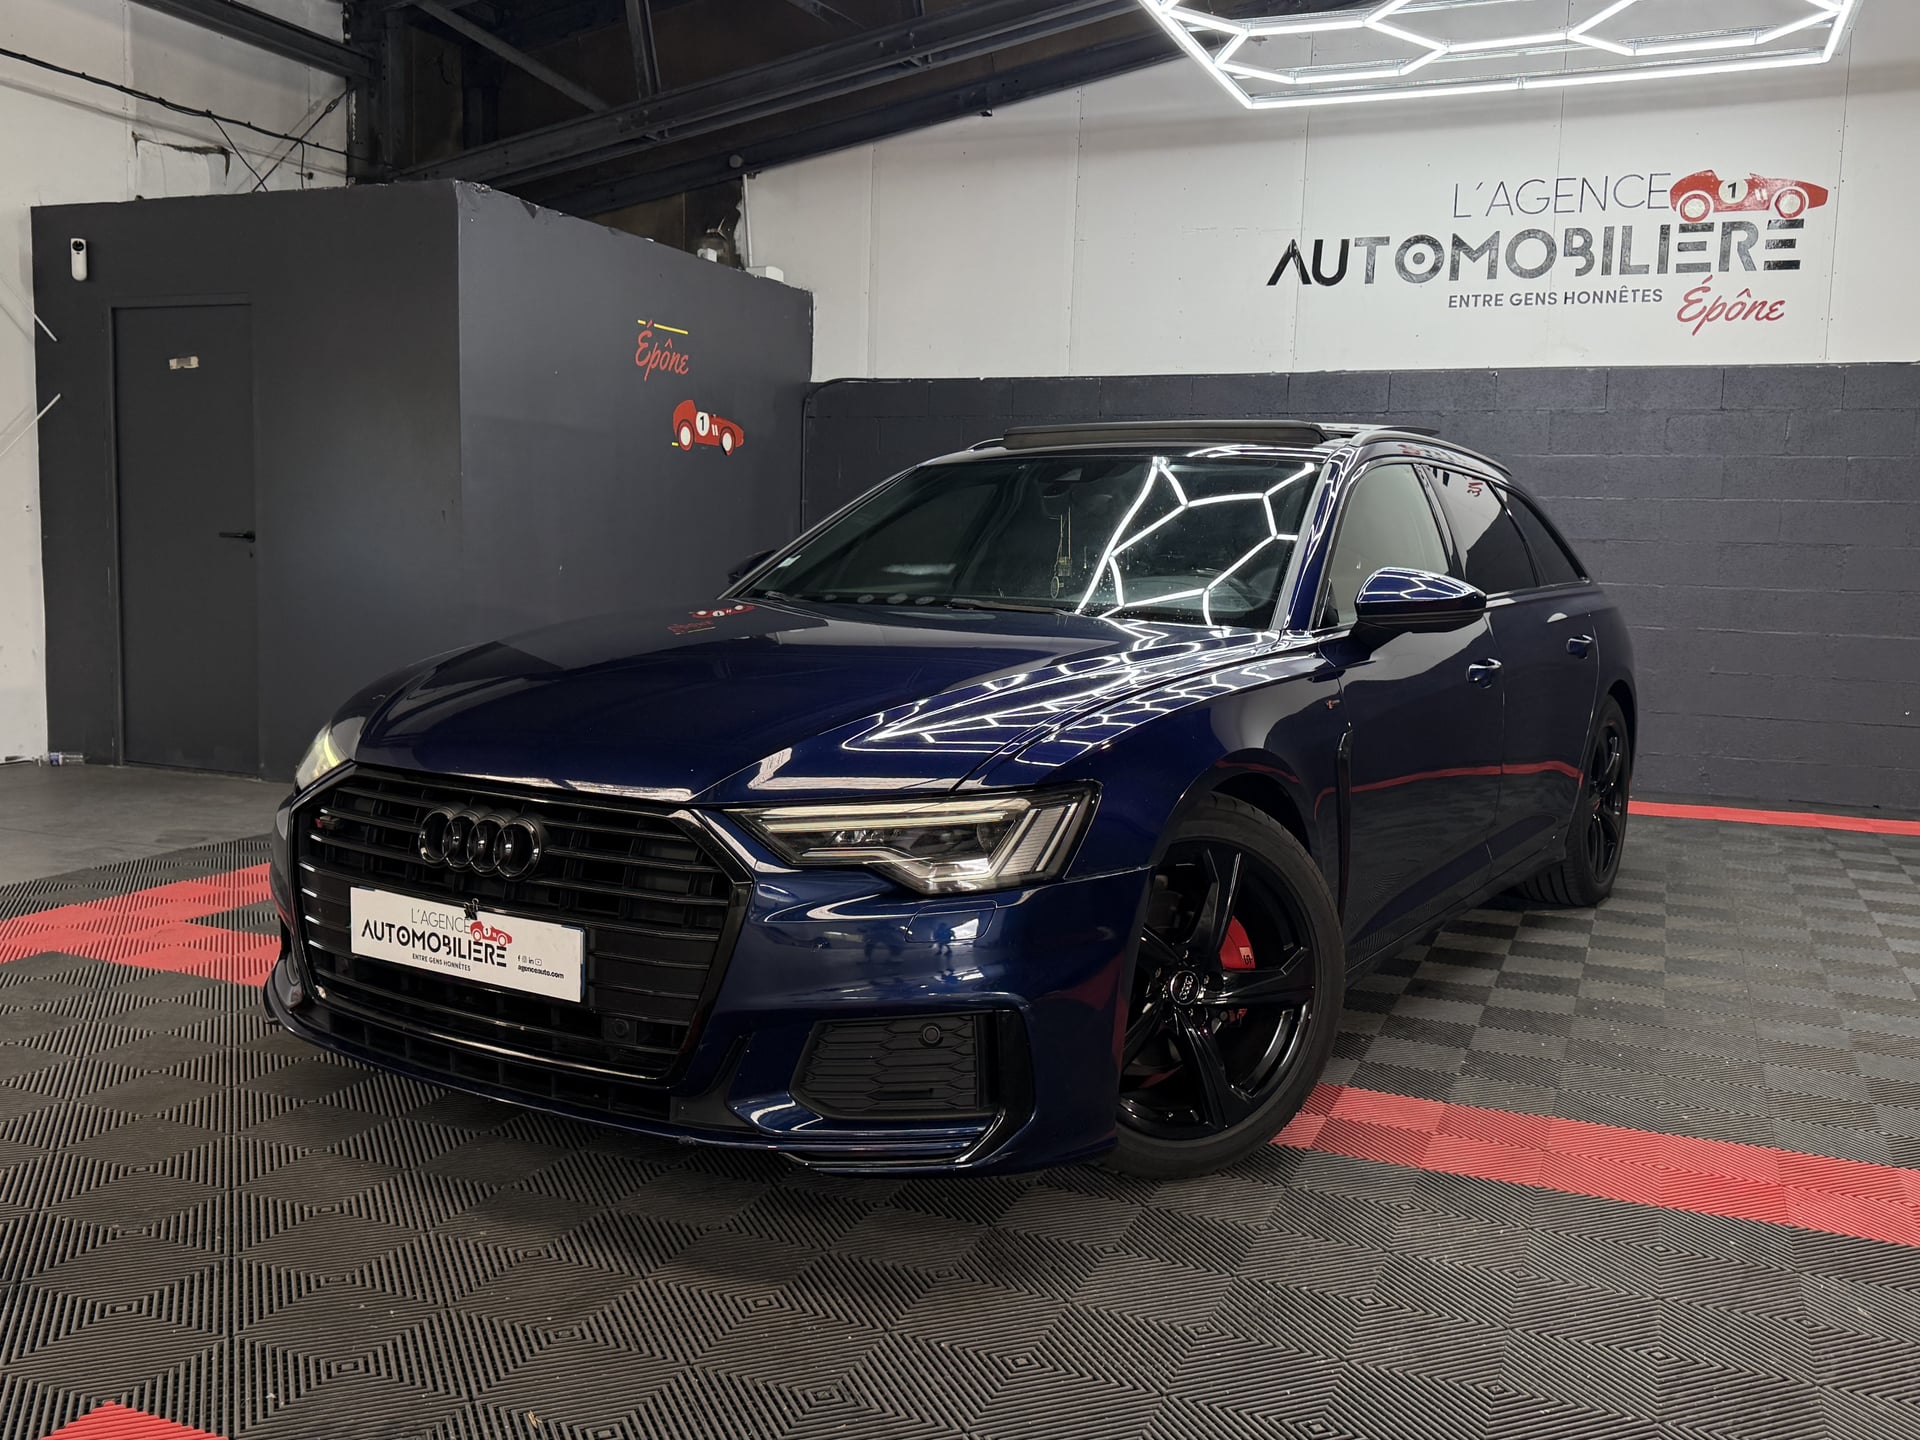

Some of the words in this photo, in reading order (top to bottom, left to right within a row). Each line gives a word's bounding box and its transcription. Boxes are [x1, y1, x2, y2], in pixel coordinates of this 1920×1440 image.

[1726, 181, 1739, 199] 1
[1448, 292, 1503, 309] ENTRE
[1509, 290, 1558, 307] GENS
[1563, 285, 1663, 305] HONNÊTES
[1676, 275, 1785, 336] Épône
[635, 320, 689, 382] Épône
[412, 953, 428, 963] ENTRE
[429, 957, 443, 966] GENS
[443, 959, 471, 972] HONNÊTES
[518, 965, 564, 979] agenceauto.com
